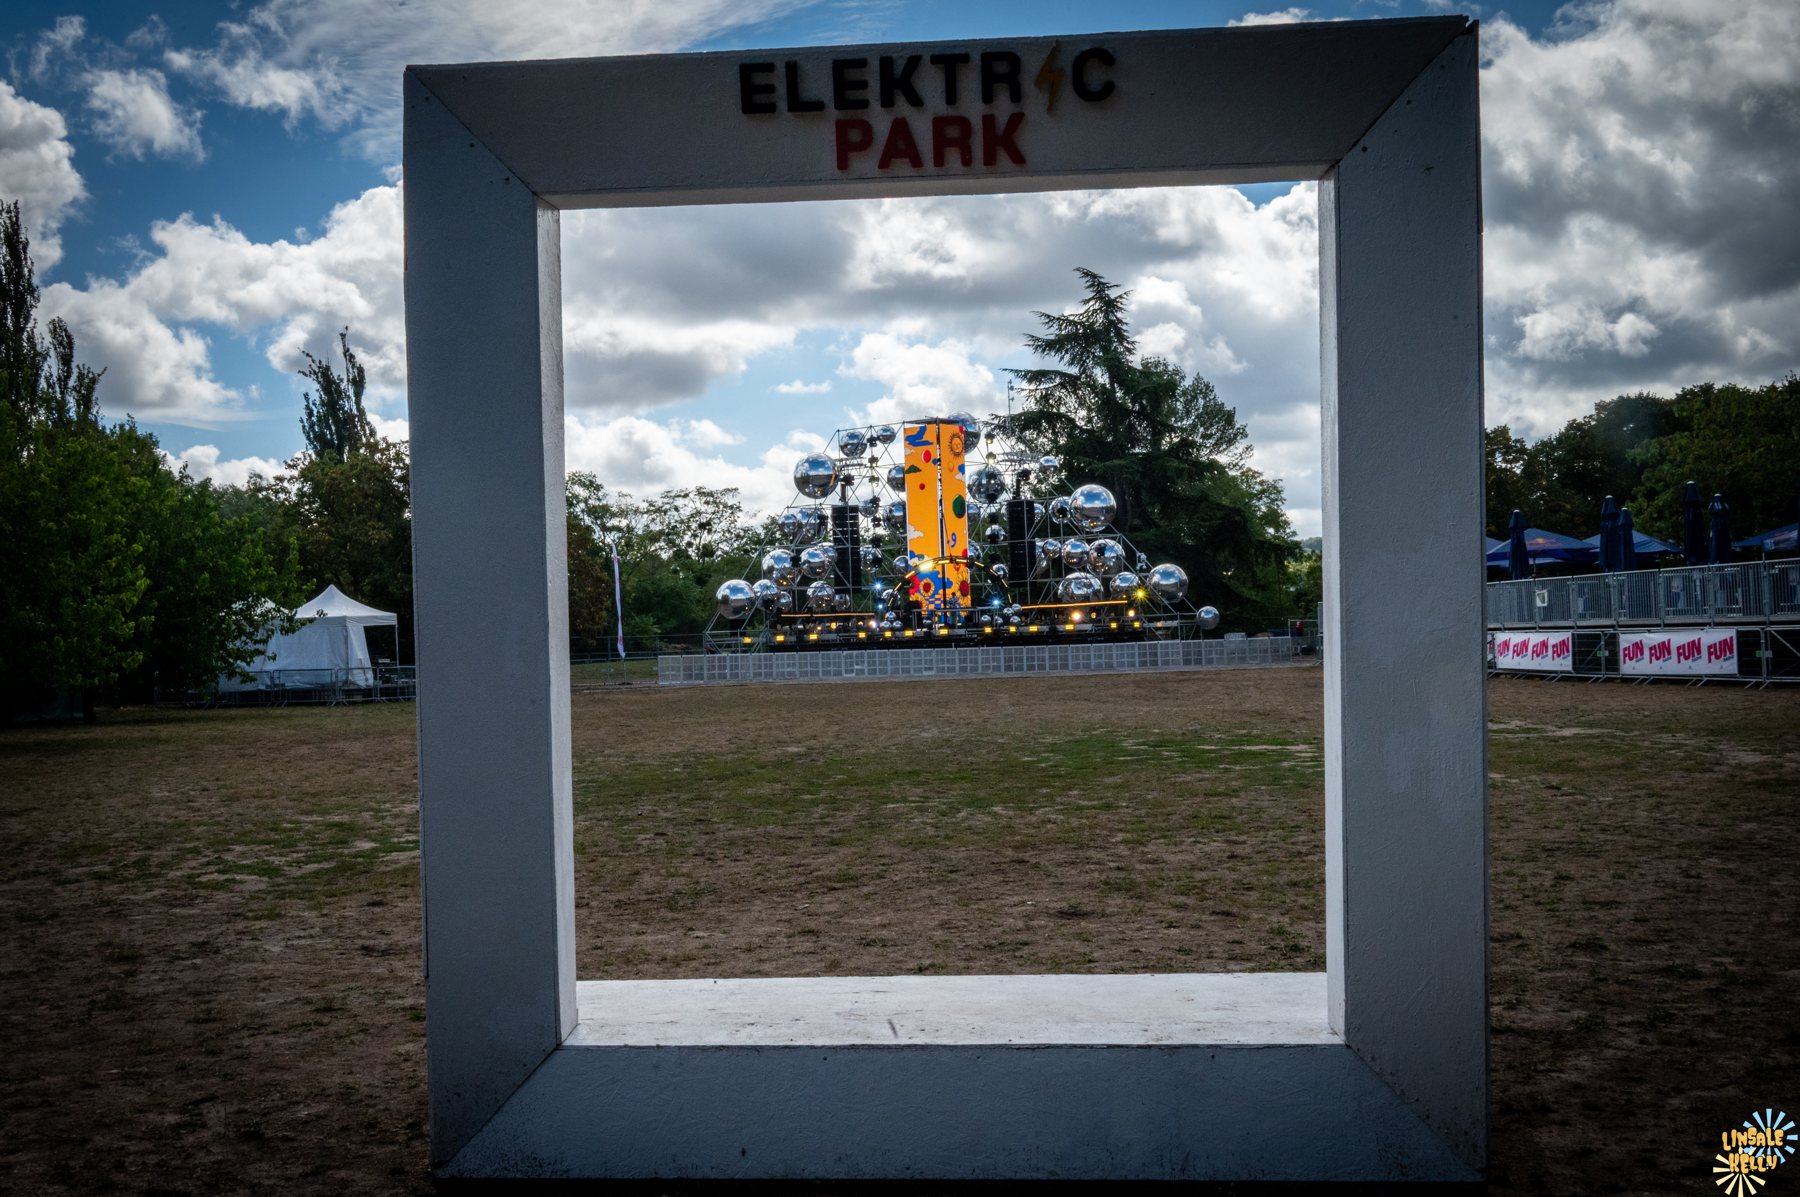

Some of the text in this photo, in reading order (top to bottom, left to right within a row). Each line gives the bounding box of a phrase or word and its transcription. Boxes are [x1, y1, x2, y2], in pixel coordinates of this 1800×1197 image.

[835, 112, 1027, 170] PARK
[1512, 637, 1530, 660] FUN
[1531, 636, 1549, 660] FUN
[1552, 636, 1570, 661] FUN
[1622, 635, 1734, 664] FUN FUN FUN FUN
